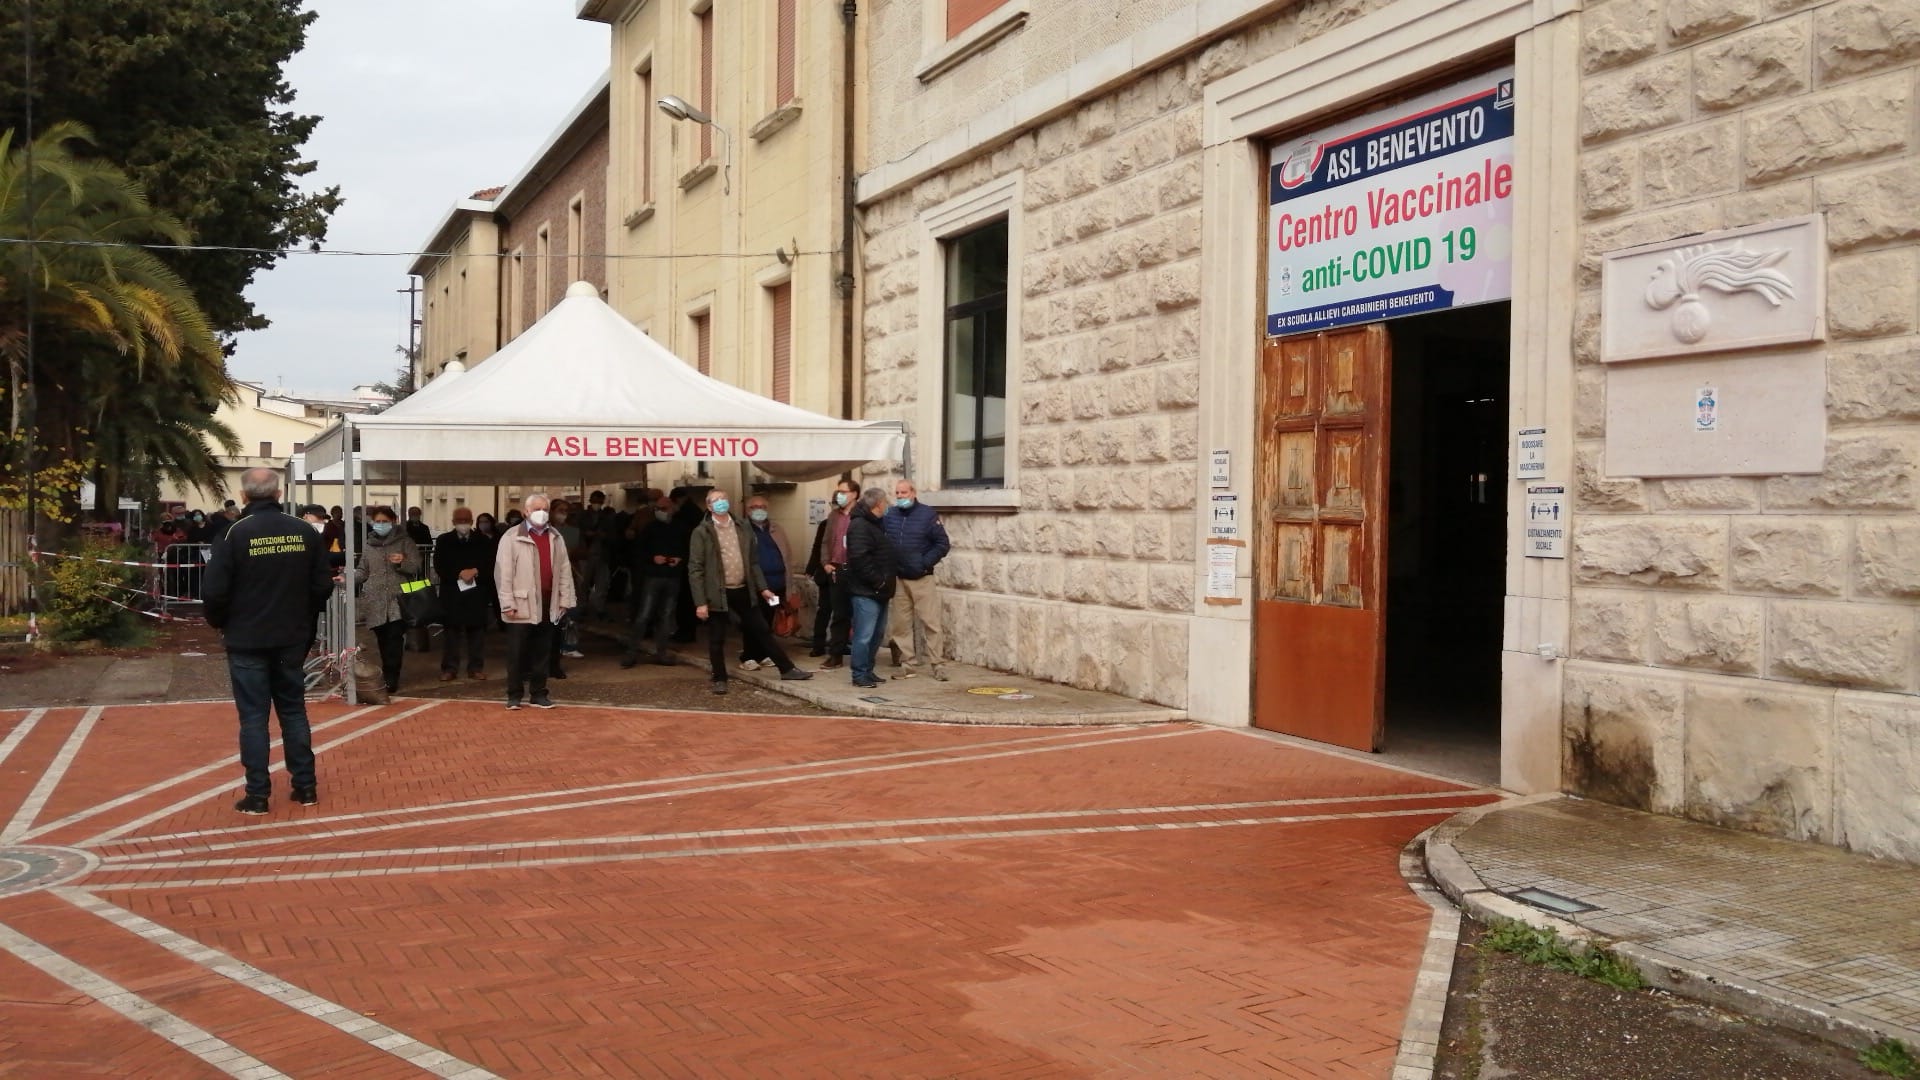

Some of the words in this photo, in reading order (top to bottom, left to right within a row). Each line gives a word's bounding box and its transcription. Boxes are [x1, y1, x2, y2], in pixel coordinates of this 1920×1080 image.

[1326, 148, 1361, 183] ASL
[1367, 106, 1485, 170] BENEVENTO
[1278, 204, 1357, 251] Centro
[1367, 158, 1512, 229] Vaccinale
[1302, 236, 1431, 293] anti-COVID
[1442, 226, 1476, 264] 19
[1277, 317, 1286, 328] EX
[1287, 312, 1313, 326] SCUOLA
[1314, 308, 1340, 322] ALLIEVI
[1341, 299, 1388, 318] CARABINIERI
[1389, 290, 1435, 310] BENEVENTO
[544, 436, 598, 457] ASL
[605, 437, 759, 457] BENEVENTO
[1529, 451, 1535, 460] LA
[248, 545, 276, 556] REGIONE
[276, 544, 306, 553] CAMPANIA
[249, 535, 286, 546] PROTEZIONE
[286, 535, 304, 543] CIVILE
